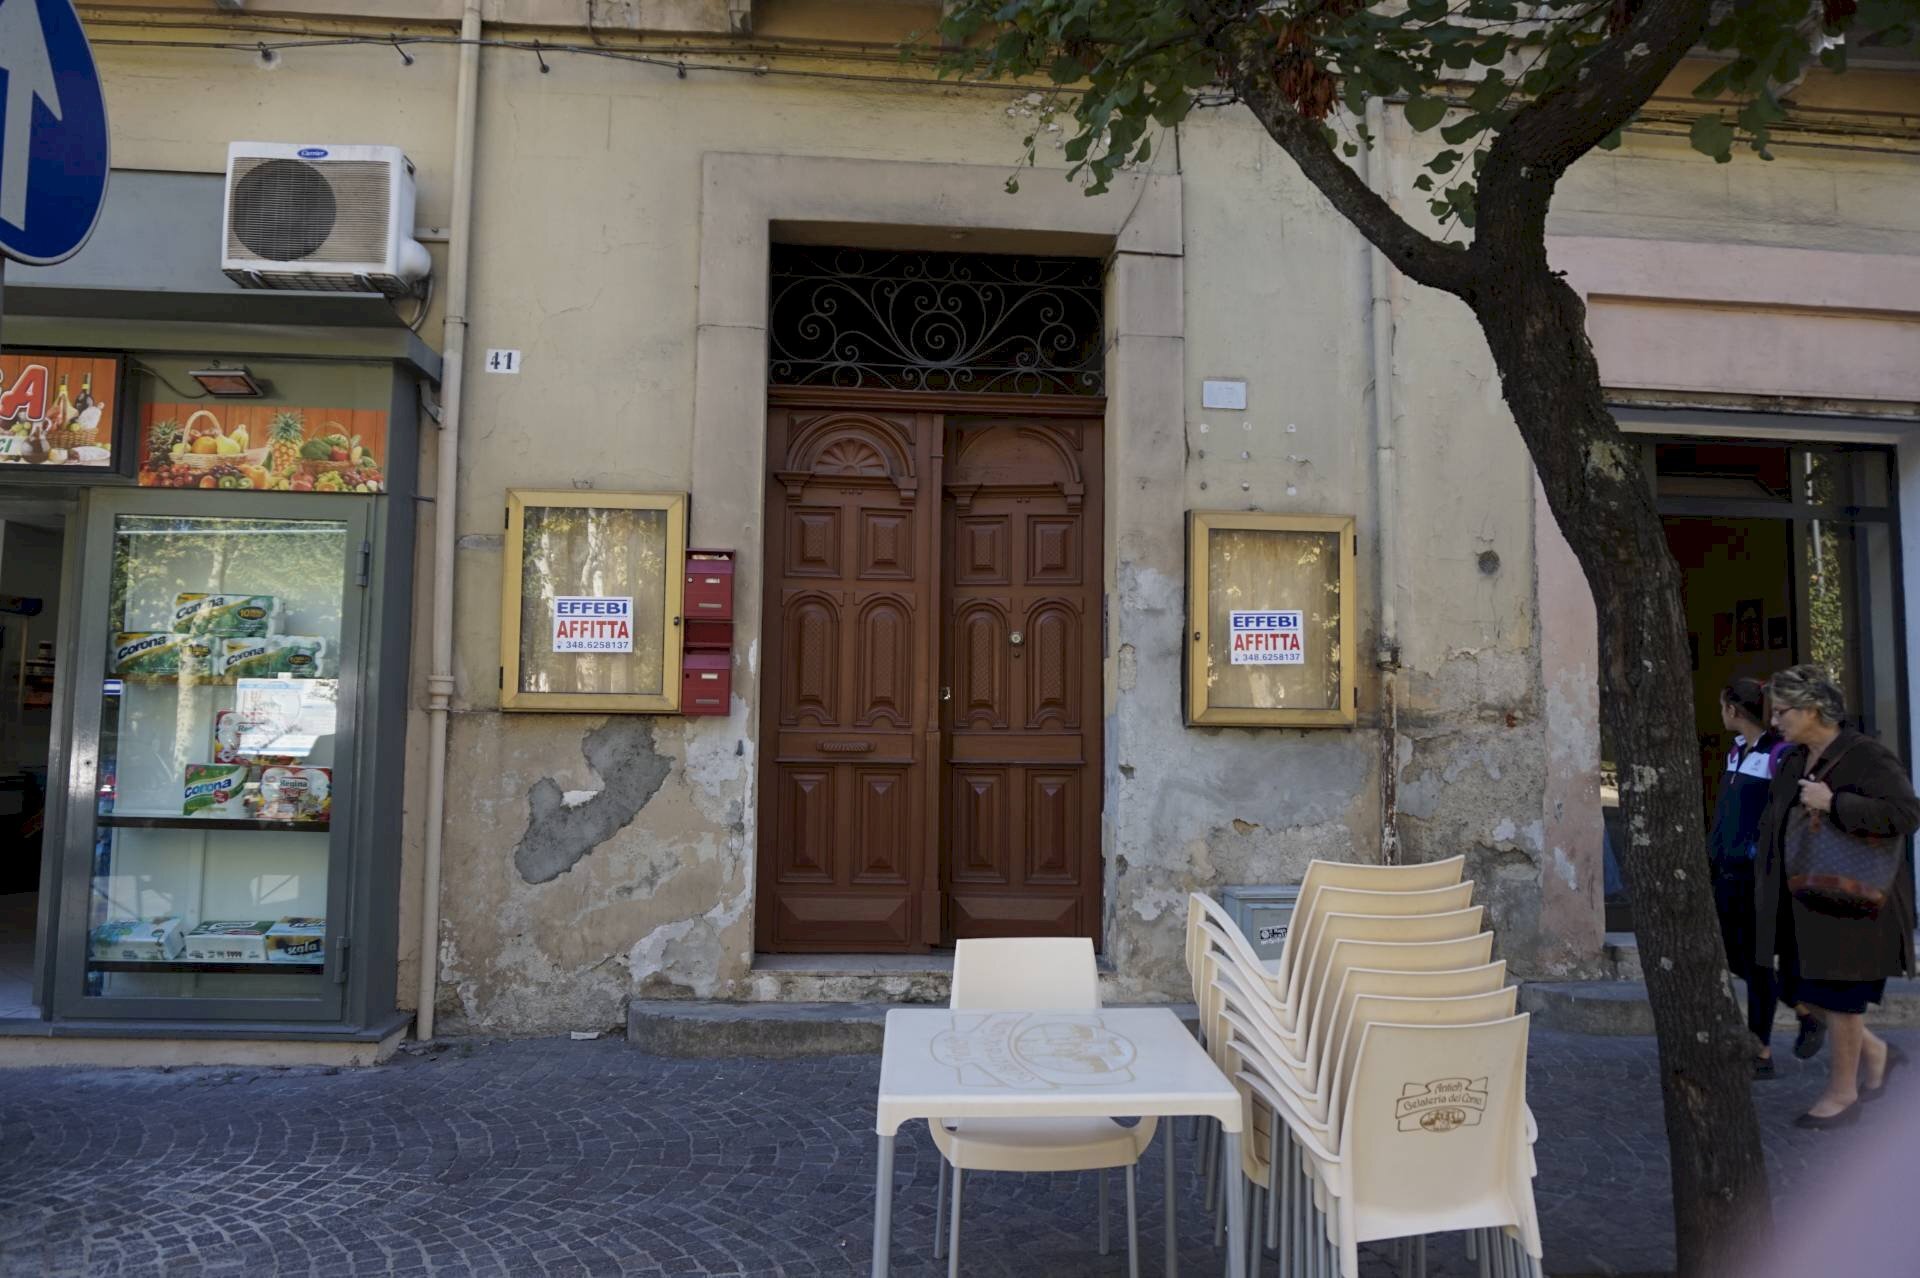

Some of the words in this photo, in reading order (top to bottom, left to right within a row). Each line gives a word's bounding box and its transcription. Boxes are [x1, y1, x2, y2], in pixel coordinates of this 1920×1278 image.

[490, 351, 512, 370] 41
[557, 602, 627, 614] EFFEBI
[556, 620, 629, 639] AFFITTA
[1233, 616, 1297, 627] EFFEBI
[117, 636, 167, 660] Corona
[566, 641, 629, 649] 348.6258137
[1234, 633, 1300, 651] AFFITTA
[226, 647, 265, 666] Corona
[1243, 653, 1301, 661] 348.6258137
[184, 778, 232, 799] Corona
